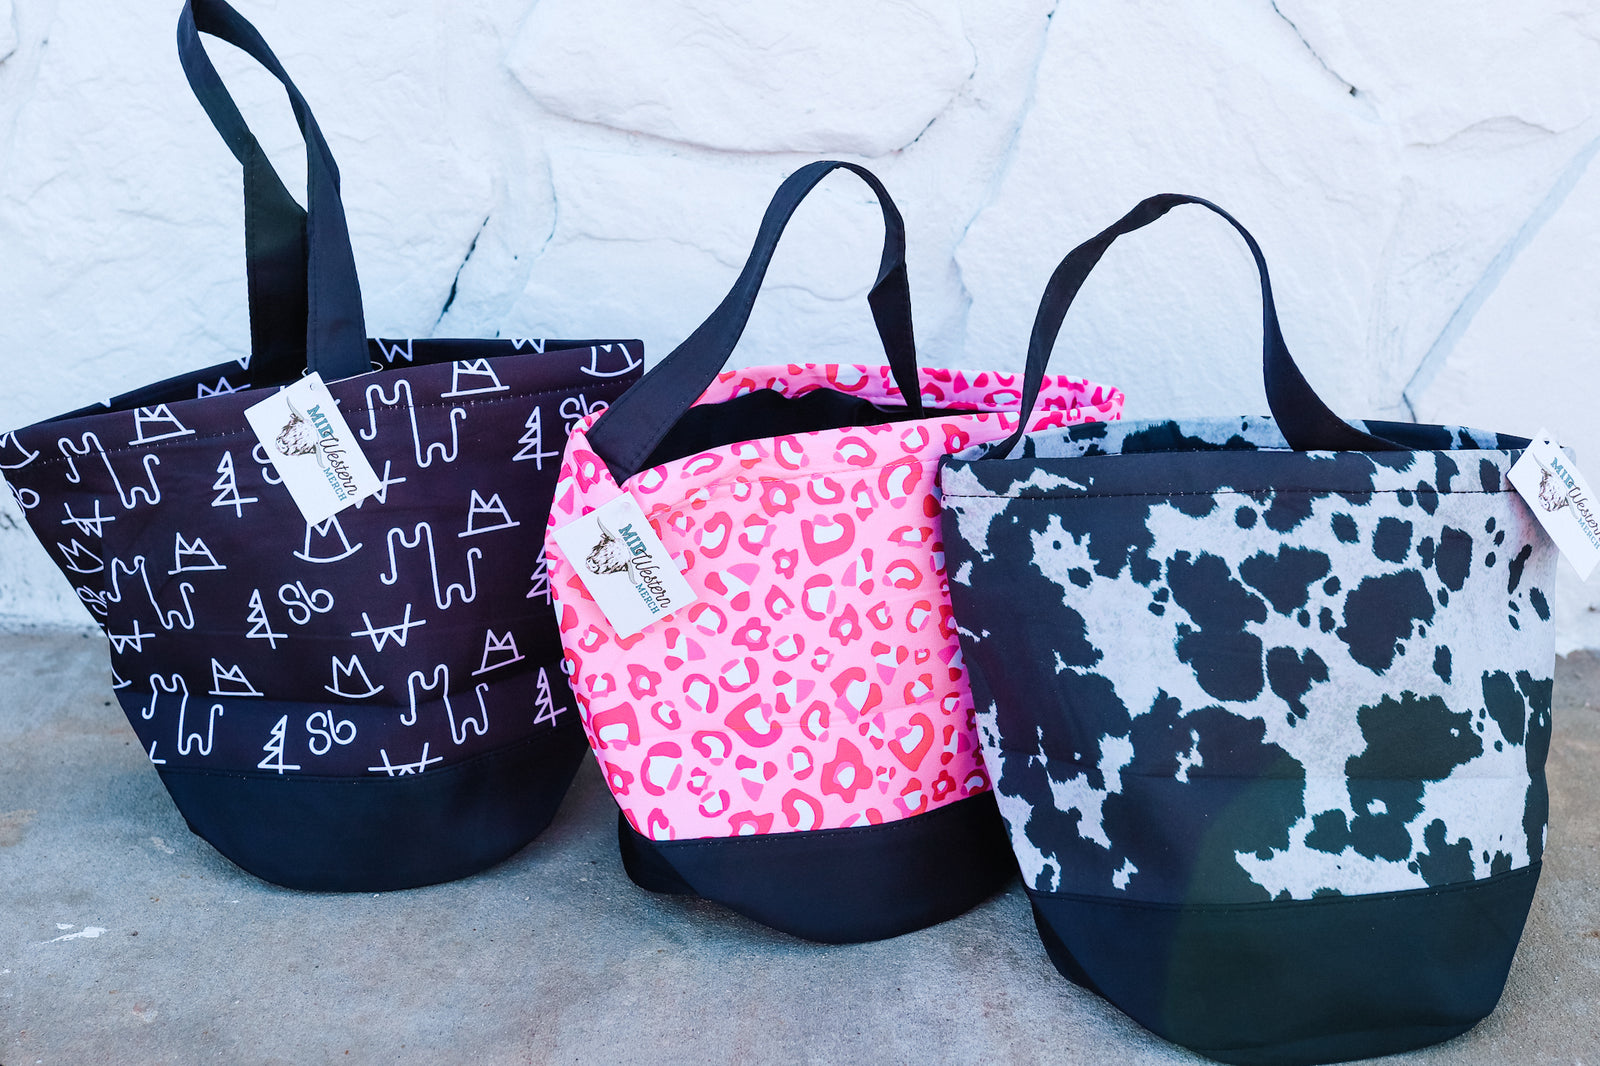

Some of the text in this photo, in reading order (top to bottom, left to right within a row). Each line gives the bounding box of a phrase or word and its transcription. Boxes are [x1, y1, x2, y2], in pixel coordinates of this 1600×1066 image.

[307, 405, 334, 438] MID
[320, 431, 357, 495] Western
[1550, 457, 1574, 489] MID
[323, 467, 347, 501] MERCH
[1568, 481, 1600, 541] Wester
[618, 523, 647, 556] MID
[1578, 517, 1600, 549] MERCH
[632, 549, 671, 608] Western
[635, 583, 660, 614] MERCH
